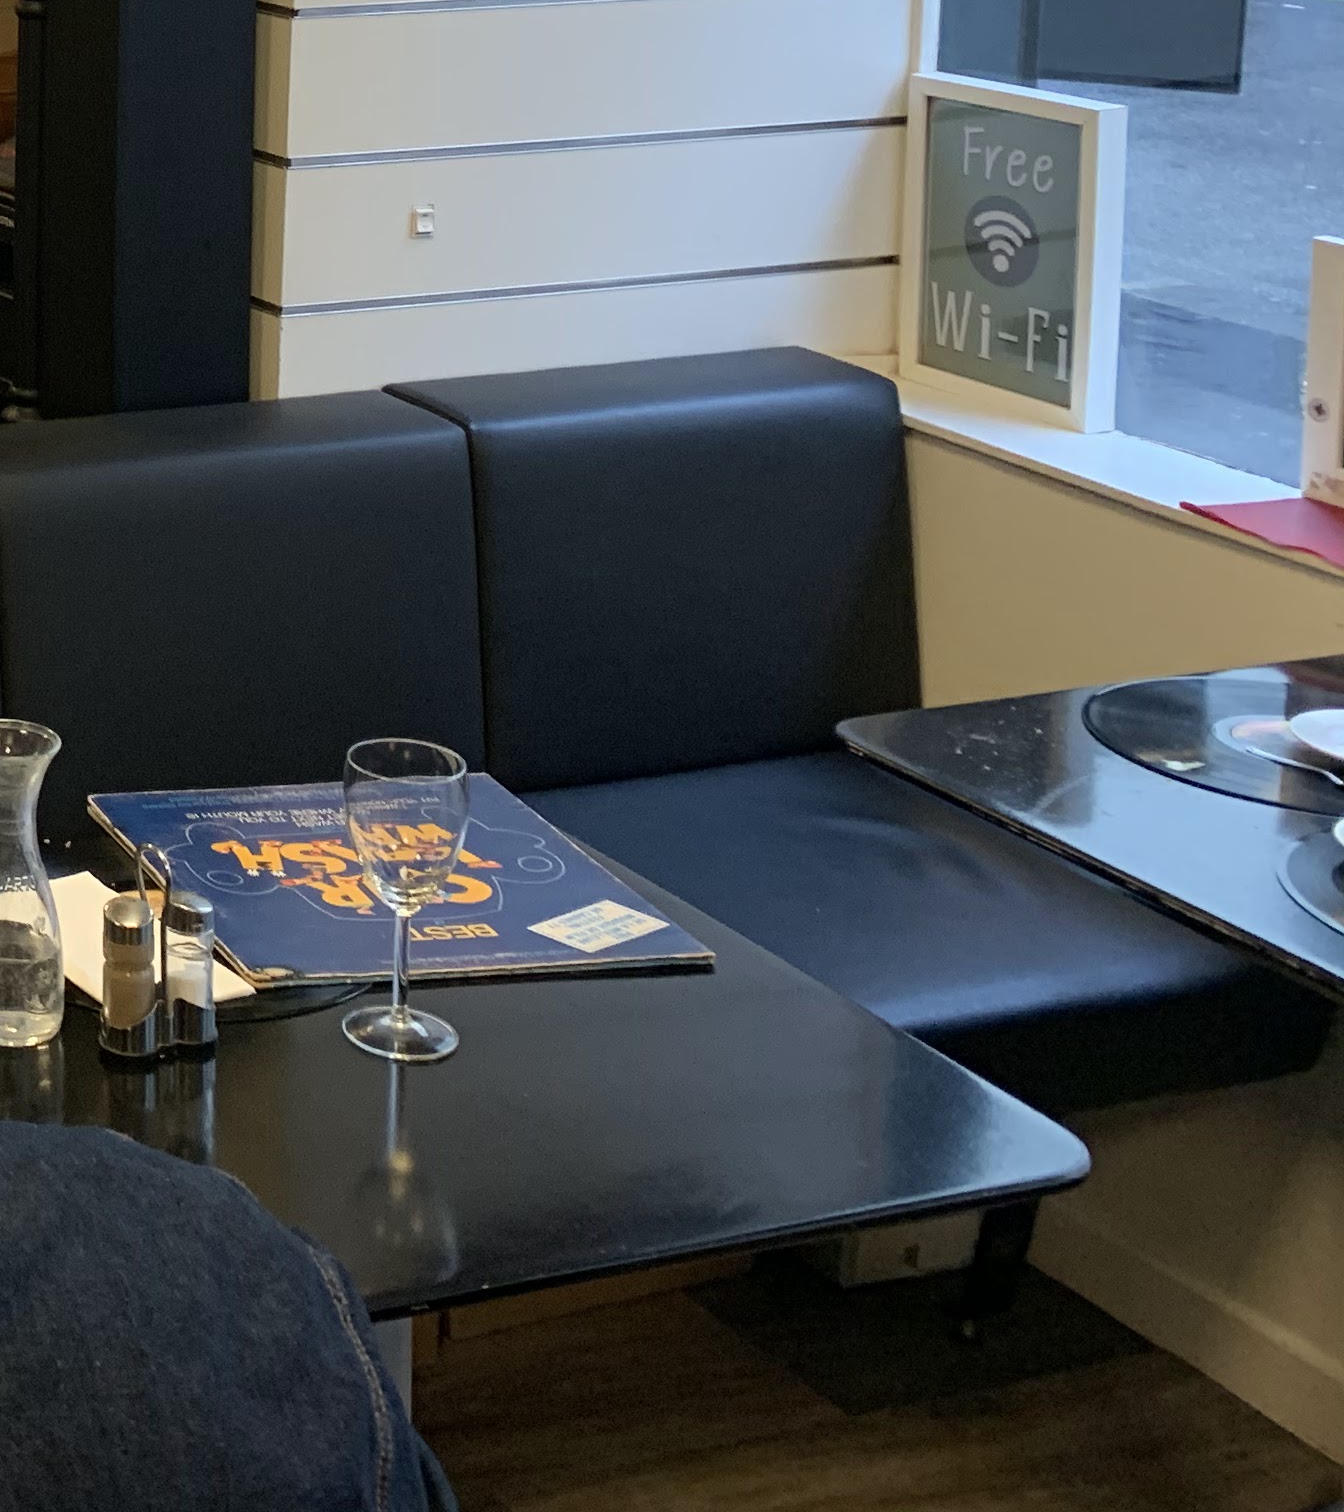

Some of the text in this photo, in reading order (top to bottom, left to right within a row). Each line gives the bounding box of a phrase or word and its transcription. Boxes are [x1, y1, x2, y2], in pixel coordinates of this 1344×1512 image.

[962, 125, 1055, 193] Free
[930, 281, 1070, 384] Wi-Fi
[202, 810, 252, 819] MOUTH
[239, 815, 287, 824] TO YOU
[252, 809, 285, 818] YOUR
[410, 923, 500, 942] BEST
